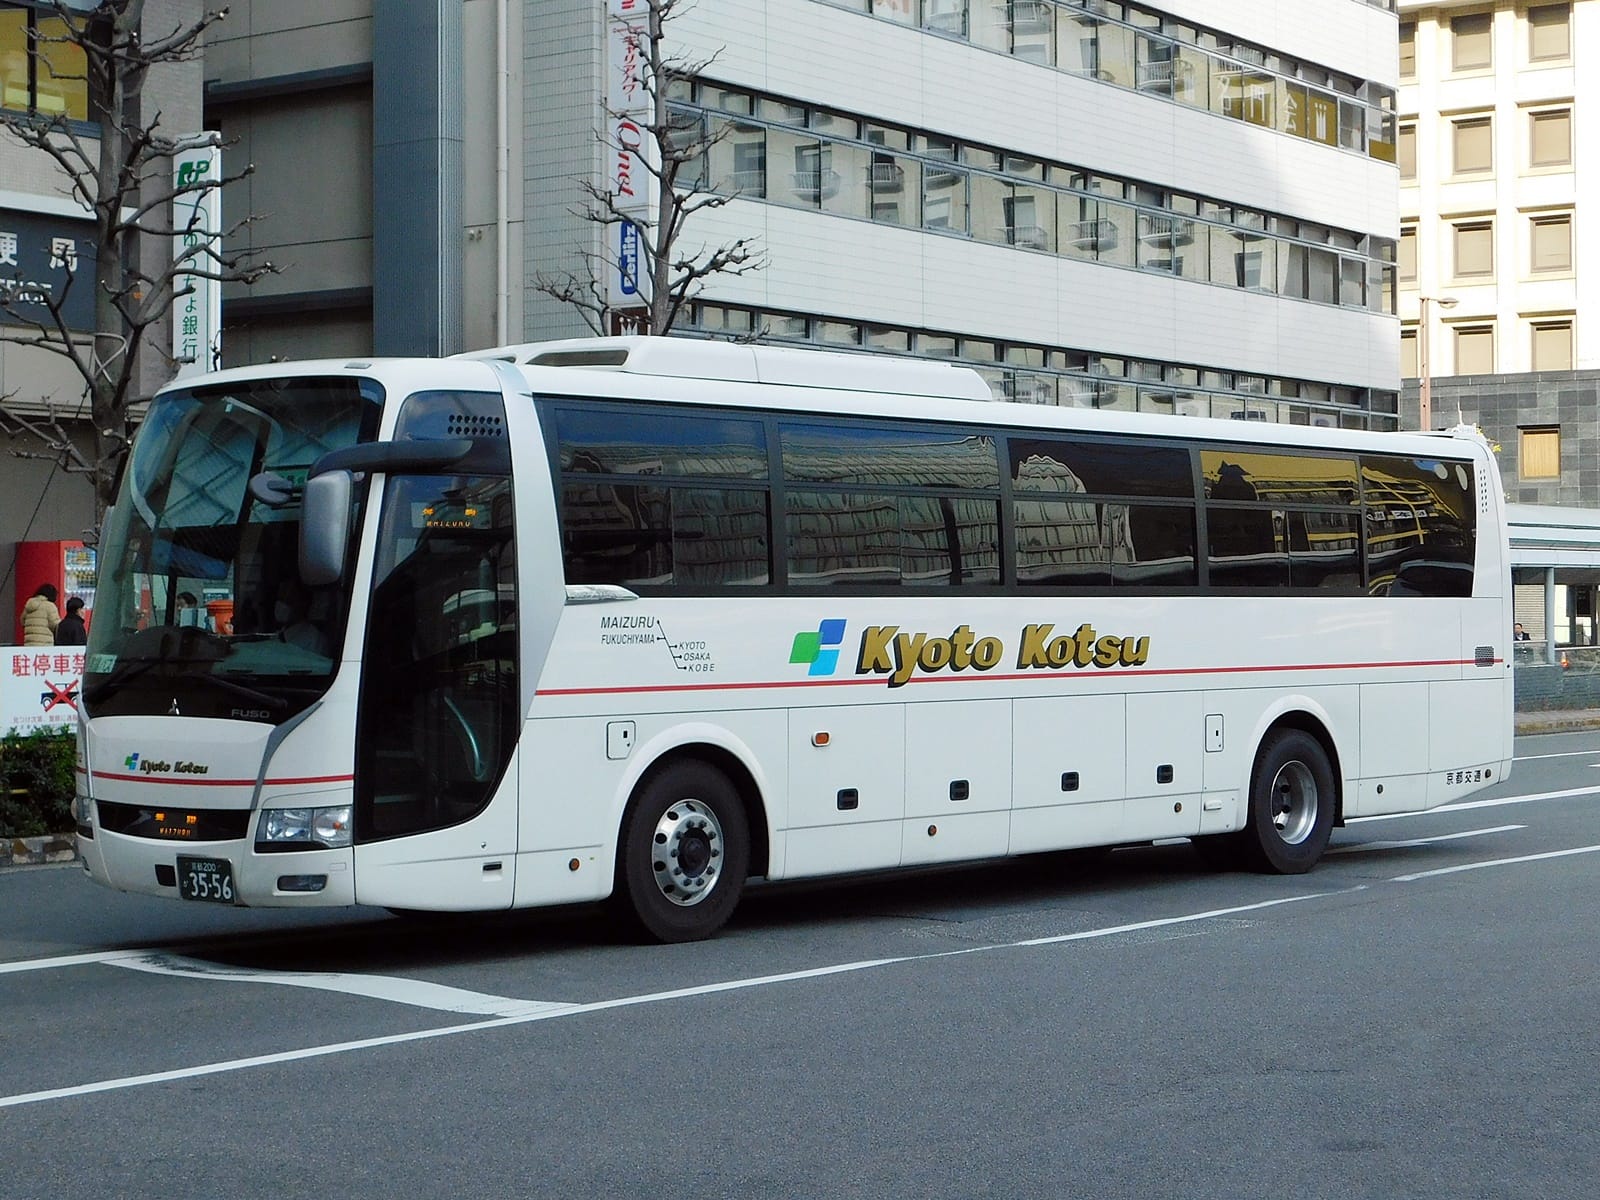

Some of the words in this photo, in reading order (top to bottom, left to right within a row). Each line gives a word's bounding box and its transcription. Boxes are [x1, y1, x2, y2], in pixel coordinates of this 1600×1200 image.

[600, 616, 655, 629] MAIZURU
[601, 633, 655, 645] FUKUCHIYAMA
[678, 641, 706, 650] KYOTO
[683, 652, 711, 662] OSAKA
[855, 624, 1004, 689] Kyoto
[1016, 623, 1150, 670] Kotsu
[688, 663, 716, 673] KOBE
[231, 708, 270, 719] FUSO
[140, 759, 171, 774] Kyoto
[174, 761, 208, 774] Kotsu
